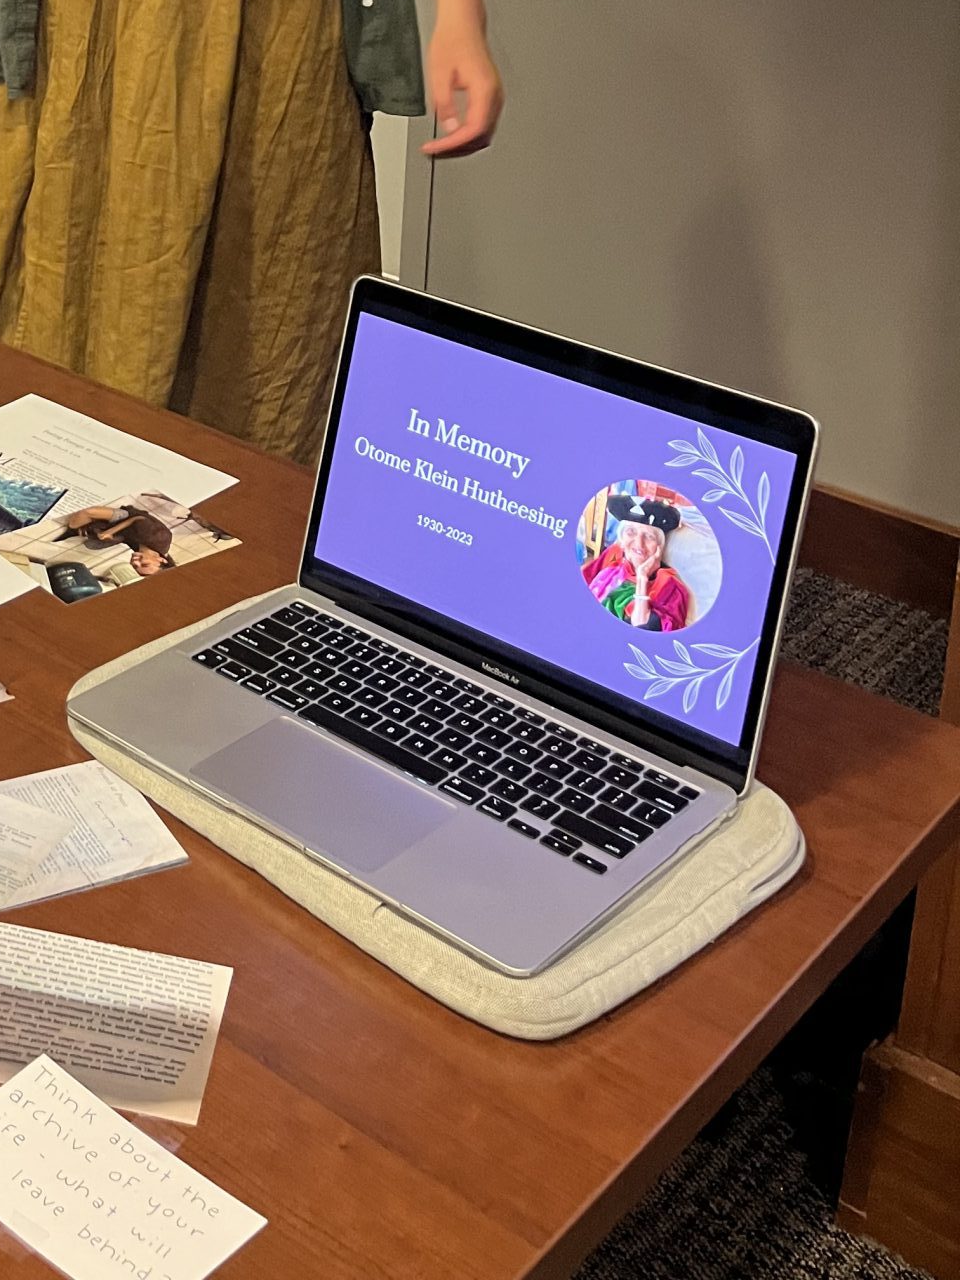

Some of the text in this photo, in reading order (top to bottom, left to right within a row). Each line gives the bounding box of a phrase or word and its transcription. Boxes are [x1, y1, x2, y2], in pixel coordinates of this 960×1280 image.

[406, 408, 531, 479] In Memory
[354, 436, 569, 539] Otome Klein Hutheesing
[416, 513, 474, 547] 1930-2023
[481, 662, 510, 680] MacBook
[9, 1088, 99, 1165] archive
[146, 1196, 204, 1239] your
[33, 1064, 221, 1219] Think about the
[11, 1169, 66, 1218] leave
[56, 1169, 118, 1218] what
[130, 1226, 171, 1260] will
